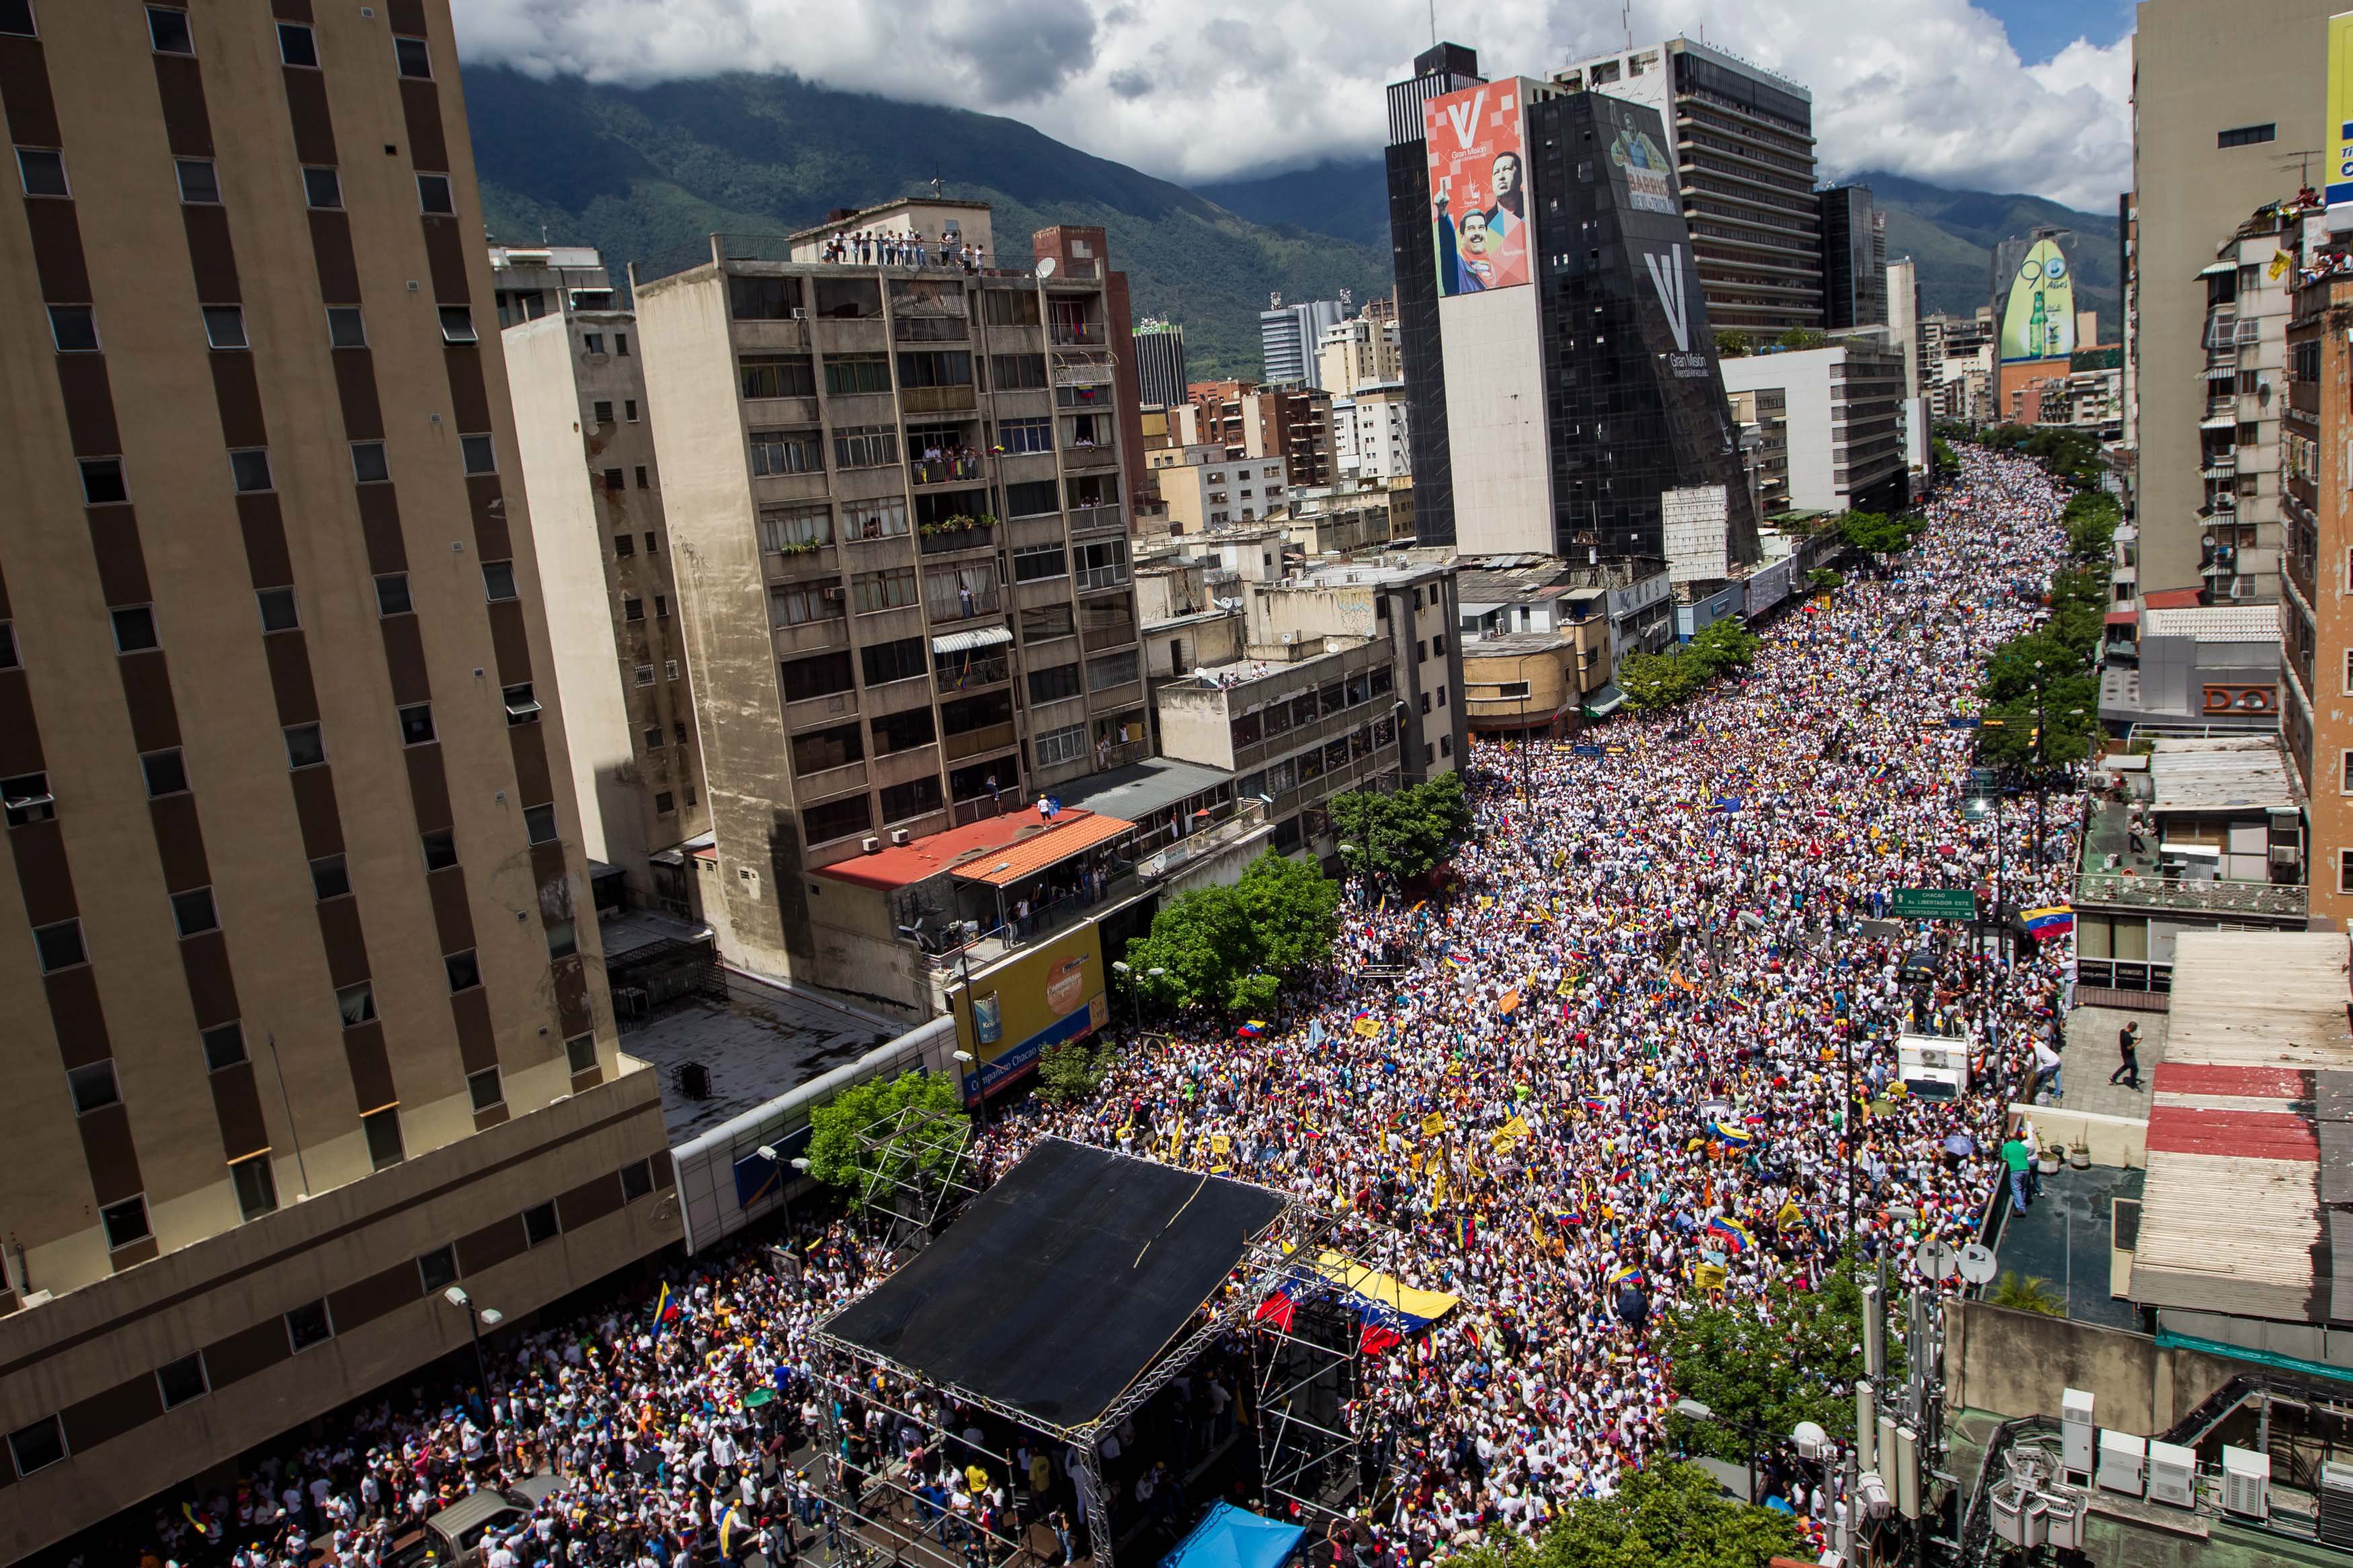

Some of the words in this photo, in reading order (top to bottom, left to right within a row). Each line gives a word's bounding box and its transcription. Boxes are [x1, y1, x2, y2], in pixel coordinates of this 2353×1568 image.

[1627, 173, 1669, 197] BARRIO
[1671, 353, 1687, 367] Gran
[1686, 352, 1707, 367] Misión
[1012, 1046, 1037, 1067] Chacao
